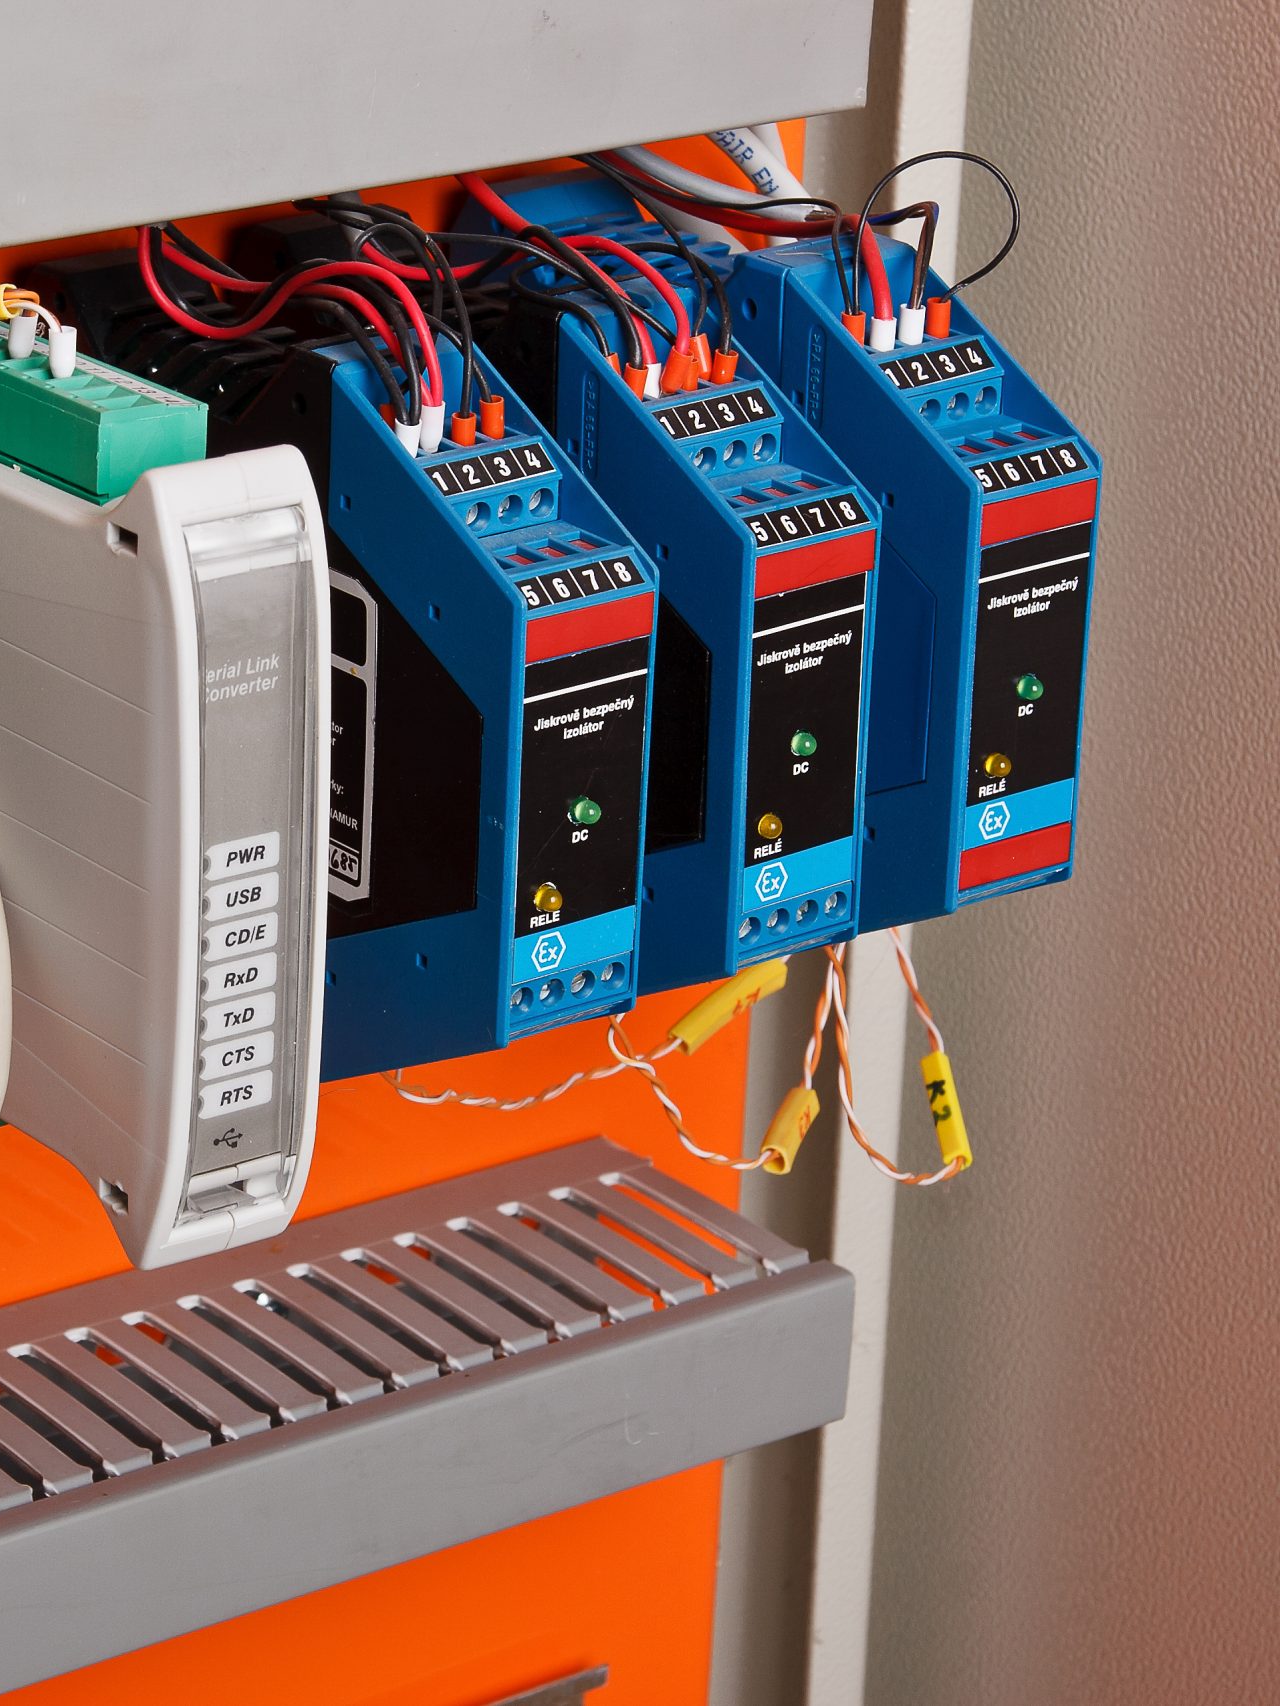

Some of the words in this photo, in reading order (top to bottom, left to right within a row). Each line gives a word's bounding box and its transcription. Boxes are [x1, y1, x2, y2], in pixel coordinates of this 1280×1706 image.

[716, 131, 754, 164] AIR
[883, 367, 900, 387] 1
[911, 361, 929, 381] 2
[939, 354, 957, 373] 3
[966, 347, 983, 366] 4
[659, 415, 676, 435] 1
[687, 409, 706, 430] 2
[717, 402, 736, 422] 3
[747, 396, 764, 415] 4
[431, 471, 449, 492] 1
[462, 464, 481, 485] 2
[493, 456, 512, 477] 3
[525, 449, 542, 469] 4
[974, 468, 994, 488] 5
[1003, 461, 1021, 482] 6
[1030, 455, 1048, 476] 7
[1059, 448, 1077, 468] 8
[749, 521, 768, 542] 5
[780, 514, 798, 535] 6
[809, 507, 827, 528] 7
[839, 500, 857, 521] 8
[520, 585, 541, 607] 5
[552, 577, 570, 599] 6
[581, 569, 600, 591] 7
[613, 562, 632, 583] 8
[987, 589, 1029, 611] Jiskrově
[1031, 576, 1079, 598] bezpečný
[757, 642, 801, 667] Jiskrově
[803, 630, 853, 655] bezpečný
[205, 659, 242, 684] erial
[246, 653, 280, 675] Link
[533, 706, 581, 732] Jiskrově
[582, 695, 635, 720] bezpečný
[1017, 703, 1034, 717] DC
[563, 719, 605, 740] izolátor
[793, 761, 809, 775] DC
[978, 778, 1006, 798] RELÉ
[329, 810, 359, 831] AMUR
[571, 829, 589, 843] DC
[226, 845, 266, 867] PWR
[753, 838, 782, 859] RELÉ
[225, 886, 261, 908] USB
[224, 924, 267, 948] CD/E
[224, 967, 258, 988] RxD
[223, 1007, 255, 1028] TxD
[221, 1046, 255, 1067] CTS
[220, 1085, 253, 1107] RTS
